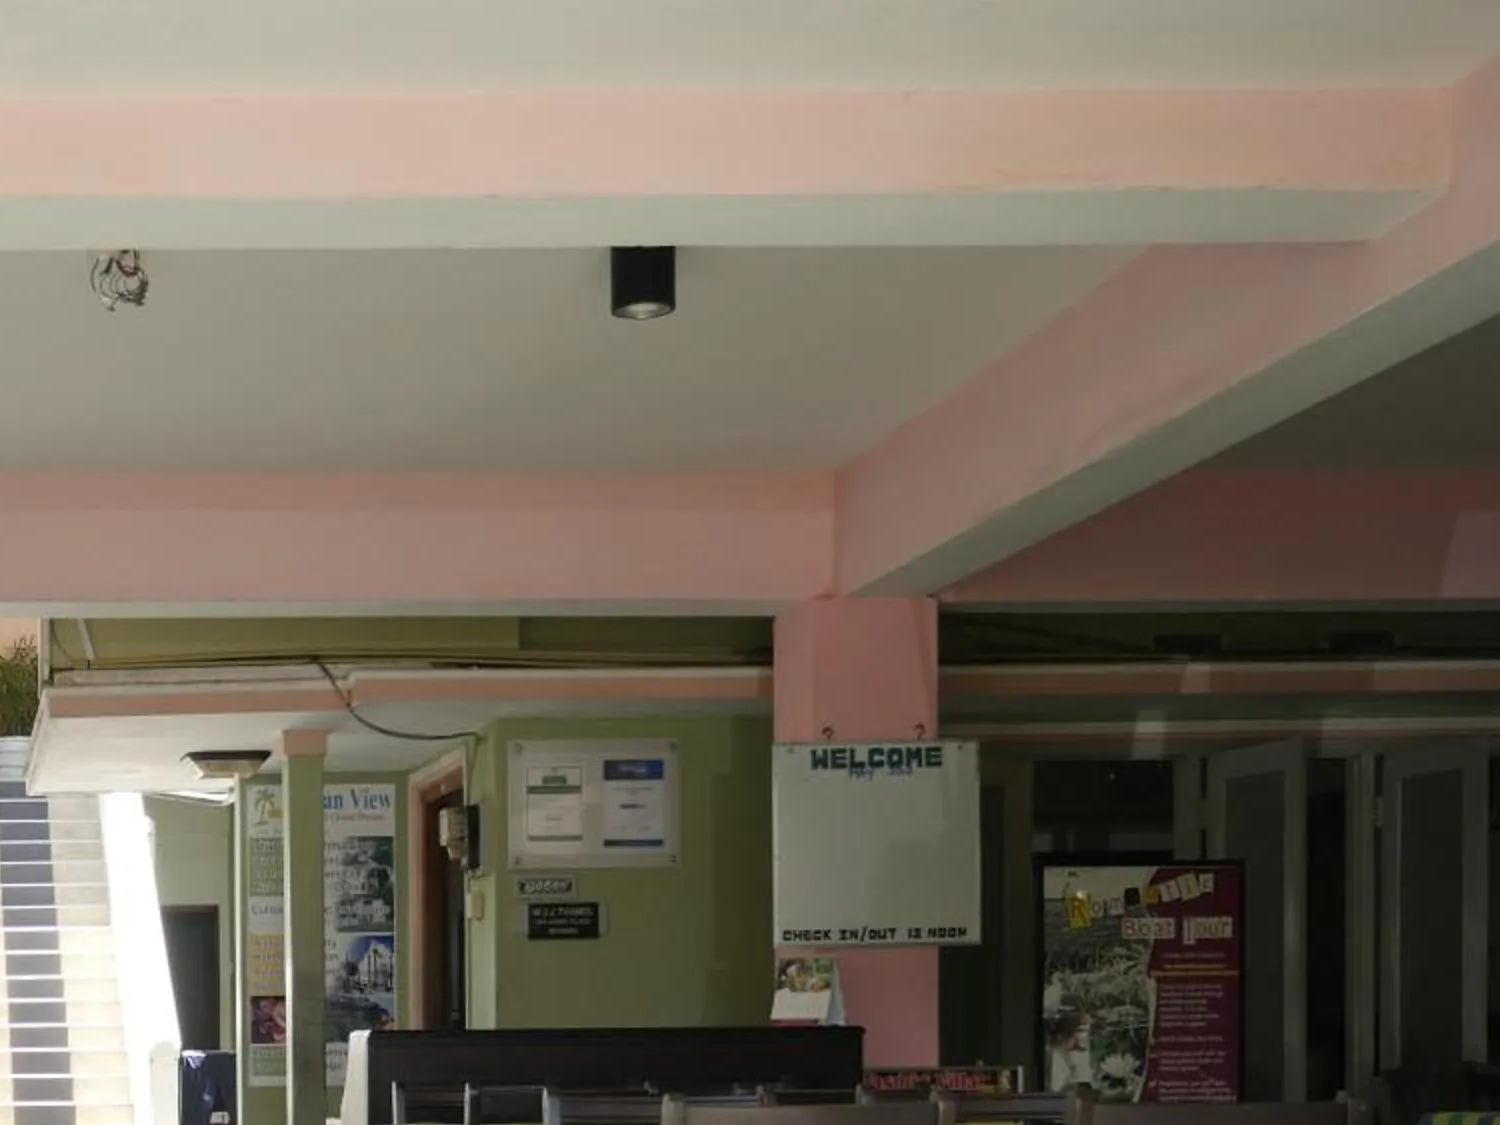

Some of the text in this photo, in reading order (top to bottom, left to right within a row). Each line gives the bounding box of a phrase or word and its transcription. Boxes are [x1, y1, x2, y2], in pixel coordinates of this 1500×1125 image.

[811, 747, 943, 770] WELCOME
[350, 787, 391, 810] View
[782, 929, 832, 941] CHECK
[840, 926, 897, 942] IN/OUT
[927, 927, 967, 938] NOON
[1123, 918, 1173, 938] Boat
